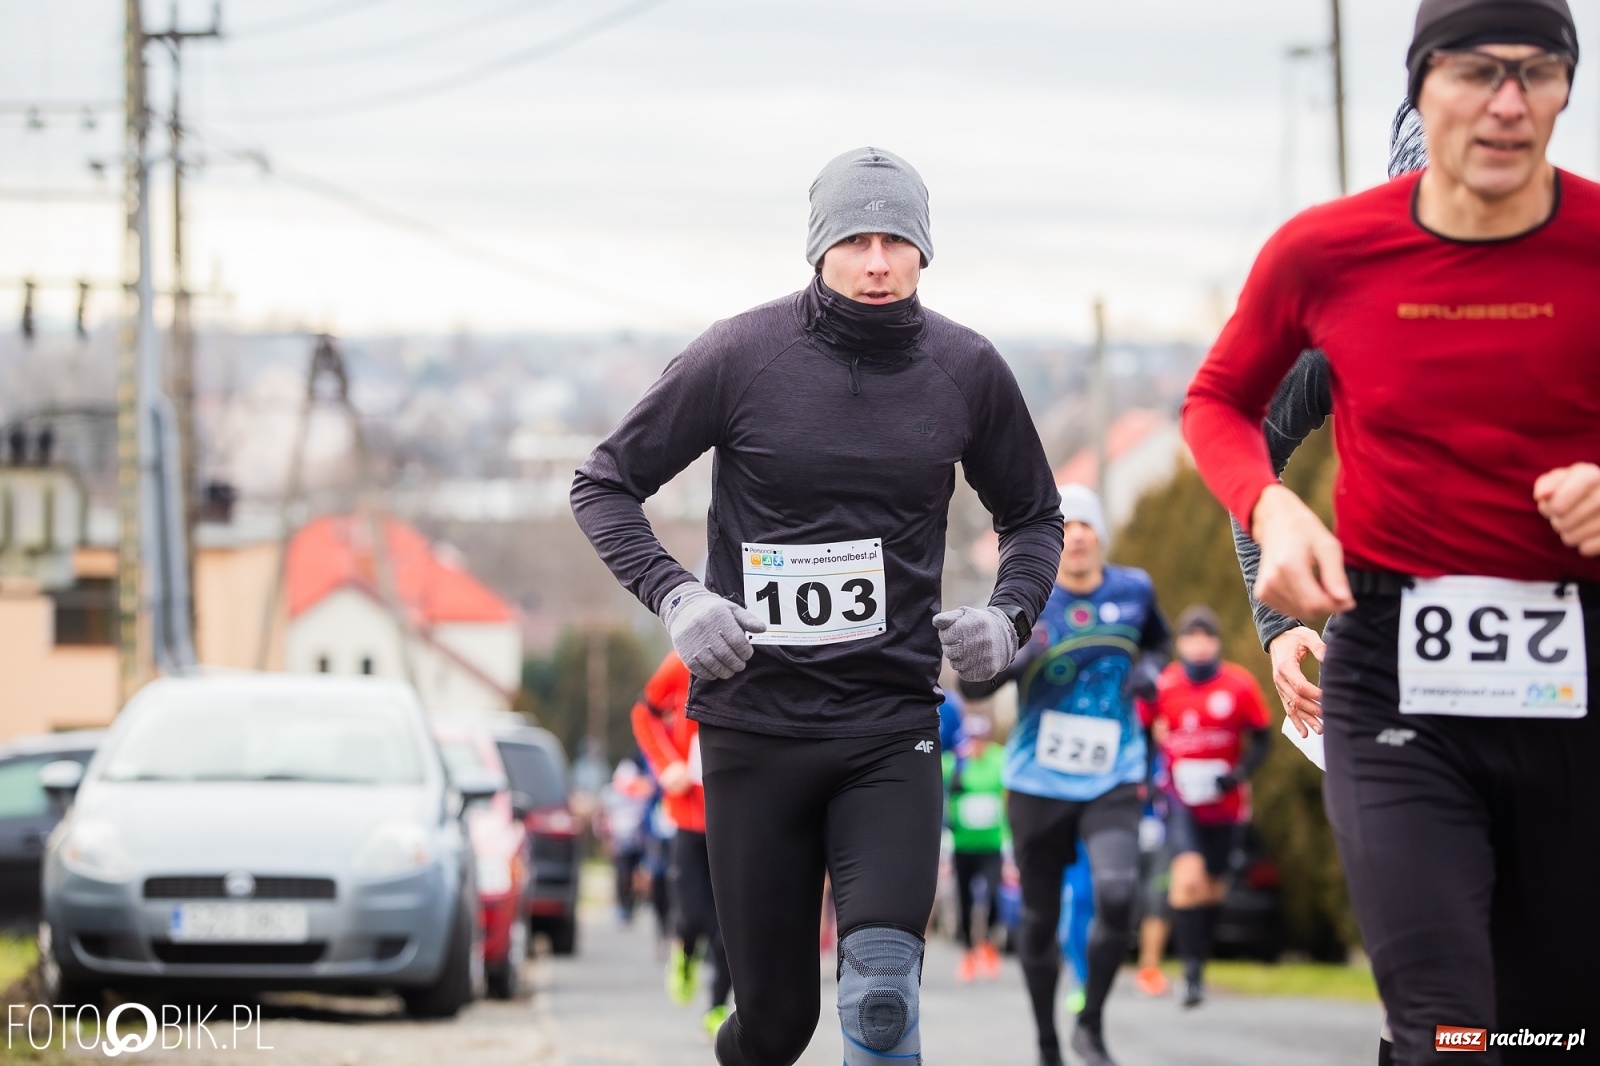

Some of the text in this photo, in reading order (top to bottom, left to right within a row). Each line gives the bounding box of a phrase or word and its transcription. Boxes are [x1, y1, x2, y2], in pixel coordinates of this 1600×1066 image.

[790, 551, 877, 565] www.personalbest.pl
[756, 578, 877, 626] 103
[1415, 606, 1568, 664] 258
[915, 740, 934, 753] 4F
[1047, 735, 1107, 766] 228
